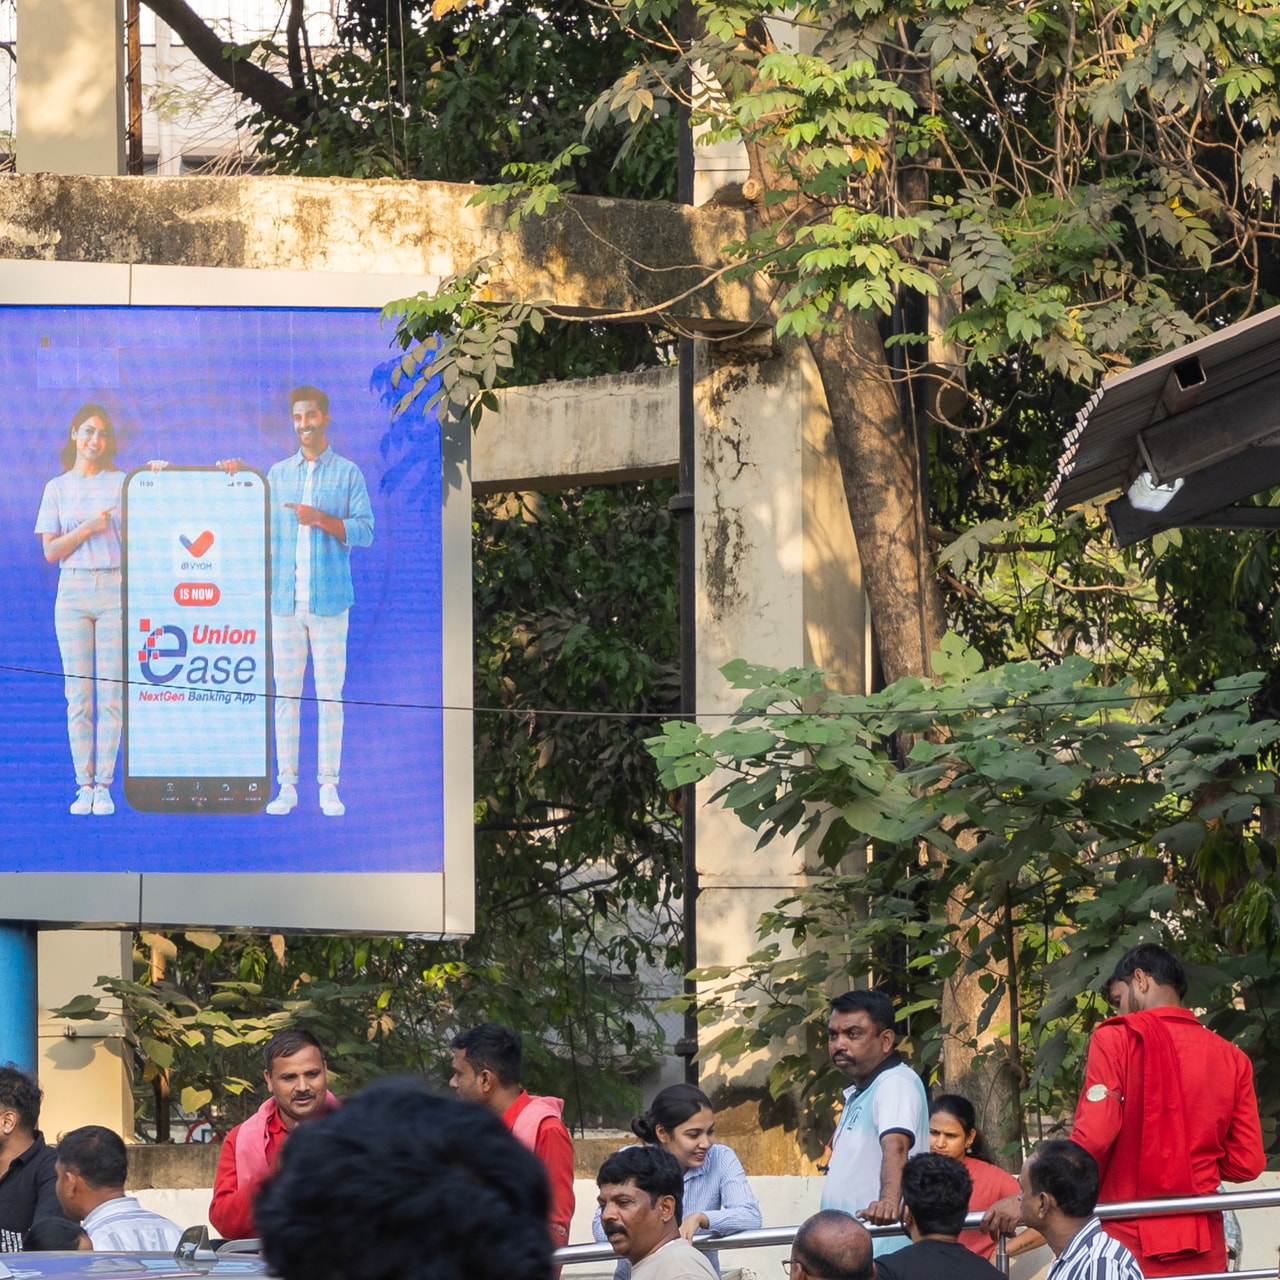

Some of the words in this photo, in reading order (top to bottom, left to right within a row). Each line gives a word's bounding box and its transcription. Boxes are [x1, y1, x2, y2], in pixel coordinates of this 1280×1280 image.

[179, 588, 189, 600] IS
[191, 588, 214, 600] NOW
[192, 624, 257, 645] Union
[139, 691, 185, 702] NextGen
[188, 691, 232, 704] Banking
[235, 692, 257, 705] App
